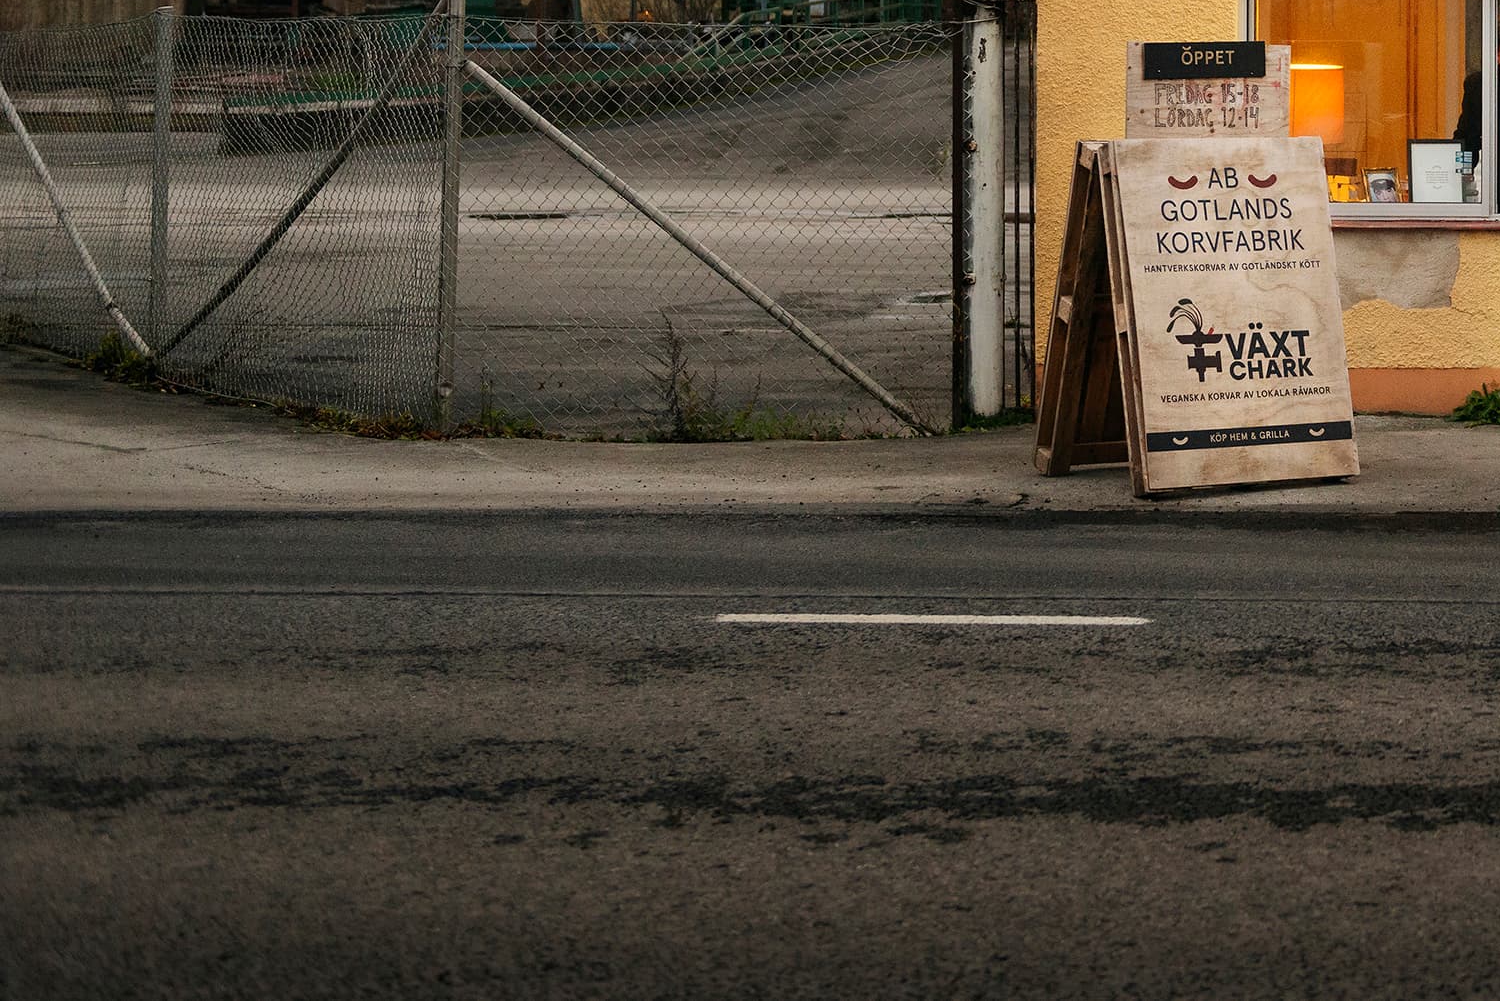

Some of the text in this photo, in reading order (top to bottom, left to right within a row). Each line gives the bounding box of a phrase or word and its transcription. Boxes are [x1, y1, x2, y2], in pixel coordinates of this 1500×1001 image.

[1154, 83, 1259, 105] FREDAG 15-18
[1154, 107, 1213, 128] LÖRDAG
[1208, 167, 1239, 189] AB
[1160, 198, 1292, 221] GOTLANDS
[1156, 229, 1304, 254] KORVFABRIK
[1144, 263, 1226, 273] HANTVERKSKORVAR
[1229, 263, 1239, 271] AV
[1241, 260, 1297, 270] GOTLÄNDSKT
[1226, 322, 1310, 359] VÄXT
[1229, 358, 1314, 381] CHARK
[1160, 386, 1331, 403] VEGANSKA KORVAR AV LOKALA RÅVAROR
[1210, 430, 1290, 443] KÖP HEM & GRILLA
